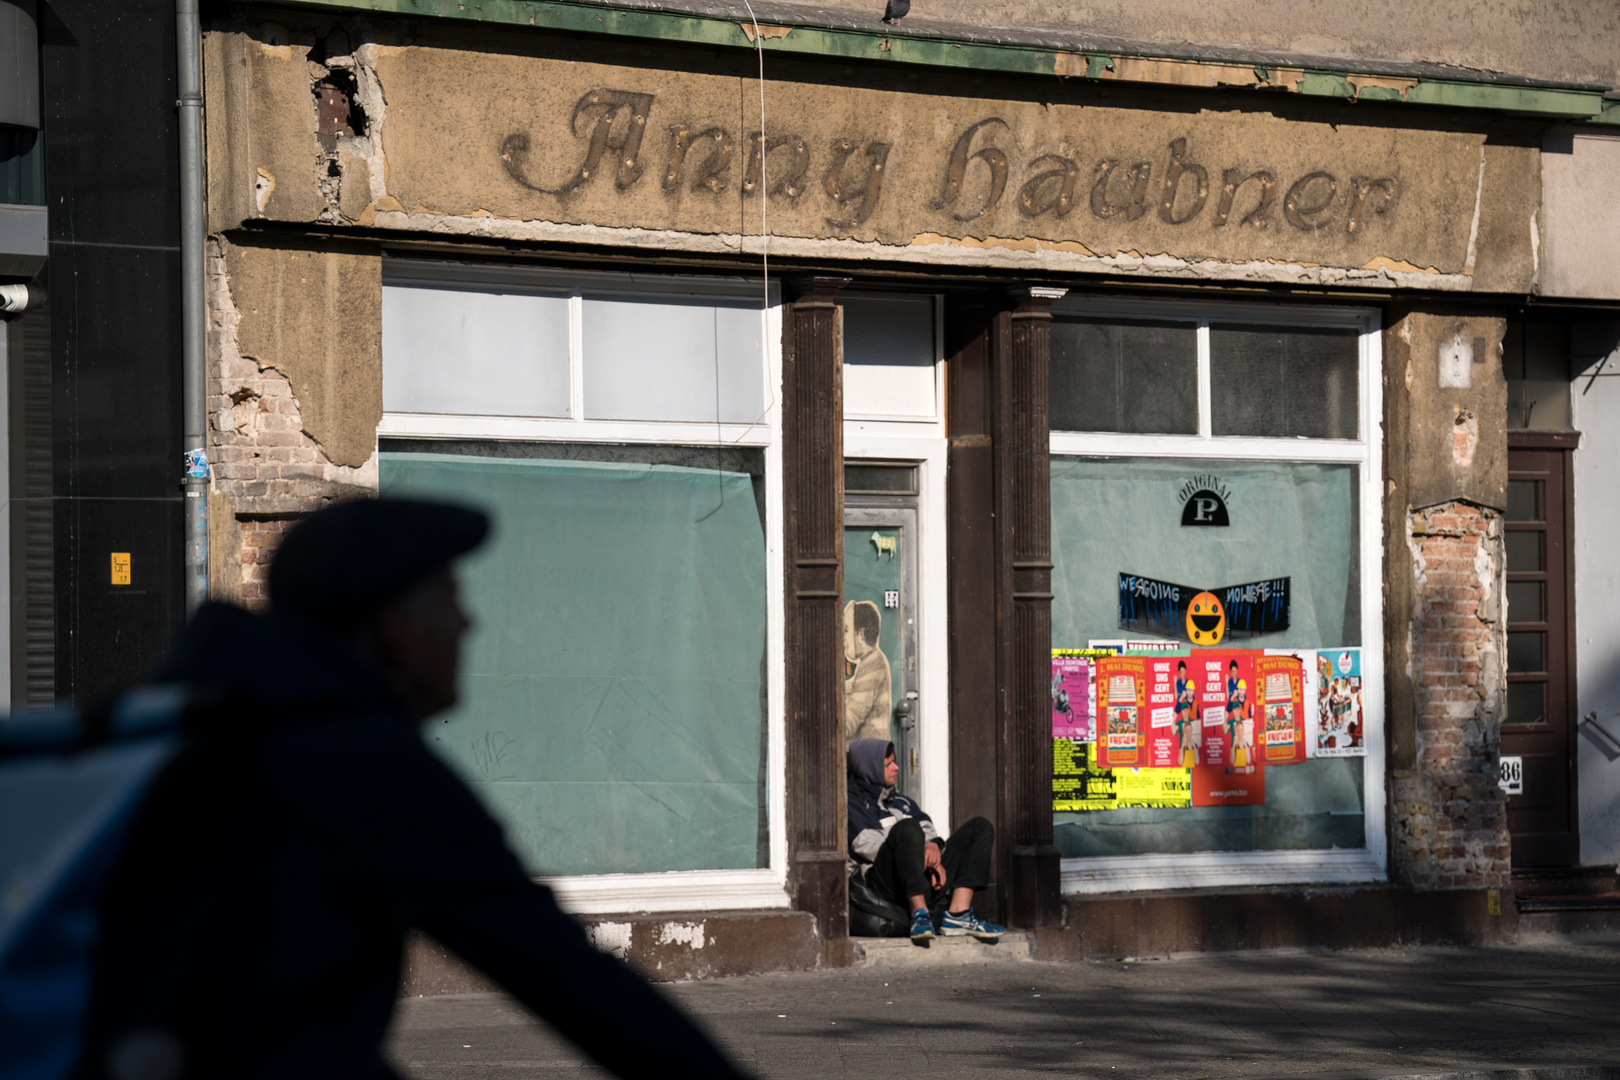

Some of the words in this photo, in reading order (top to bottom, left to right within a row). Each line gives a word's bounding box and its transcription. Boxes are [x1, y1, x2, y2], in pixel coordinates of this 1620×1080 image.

[1178, 473, 1232, 505] ORIGINAL
[1106, 662, 1121, 671] MAI
[1122, 662, 1145, 673] DEMO
[1153, 662, 1170, 672] OHNE
[1205, 661, 1222, 671] OHNE
[1262, 662, 1277, 670] MAI
[1278, 660, 1299, 670] DEMO
[1156, 673, 1168, 683] UNS
[1207, 672, 1220, 682] UNS
[1154, 683, 1170, 693] GEHT
[1206, 682, 1222, 692] GEHT
[1151, 694, 1174, 703] NICHTS!
[1203, 693, 1225, 702] NICHTS!
[1502, 761, 1520, 782] 86
